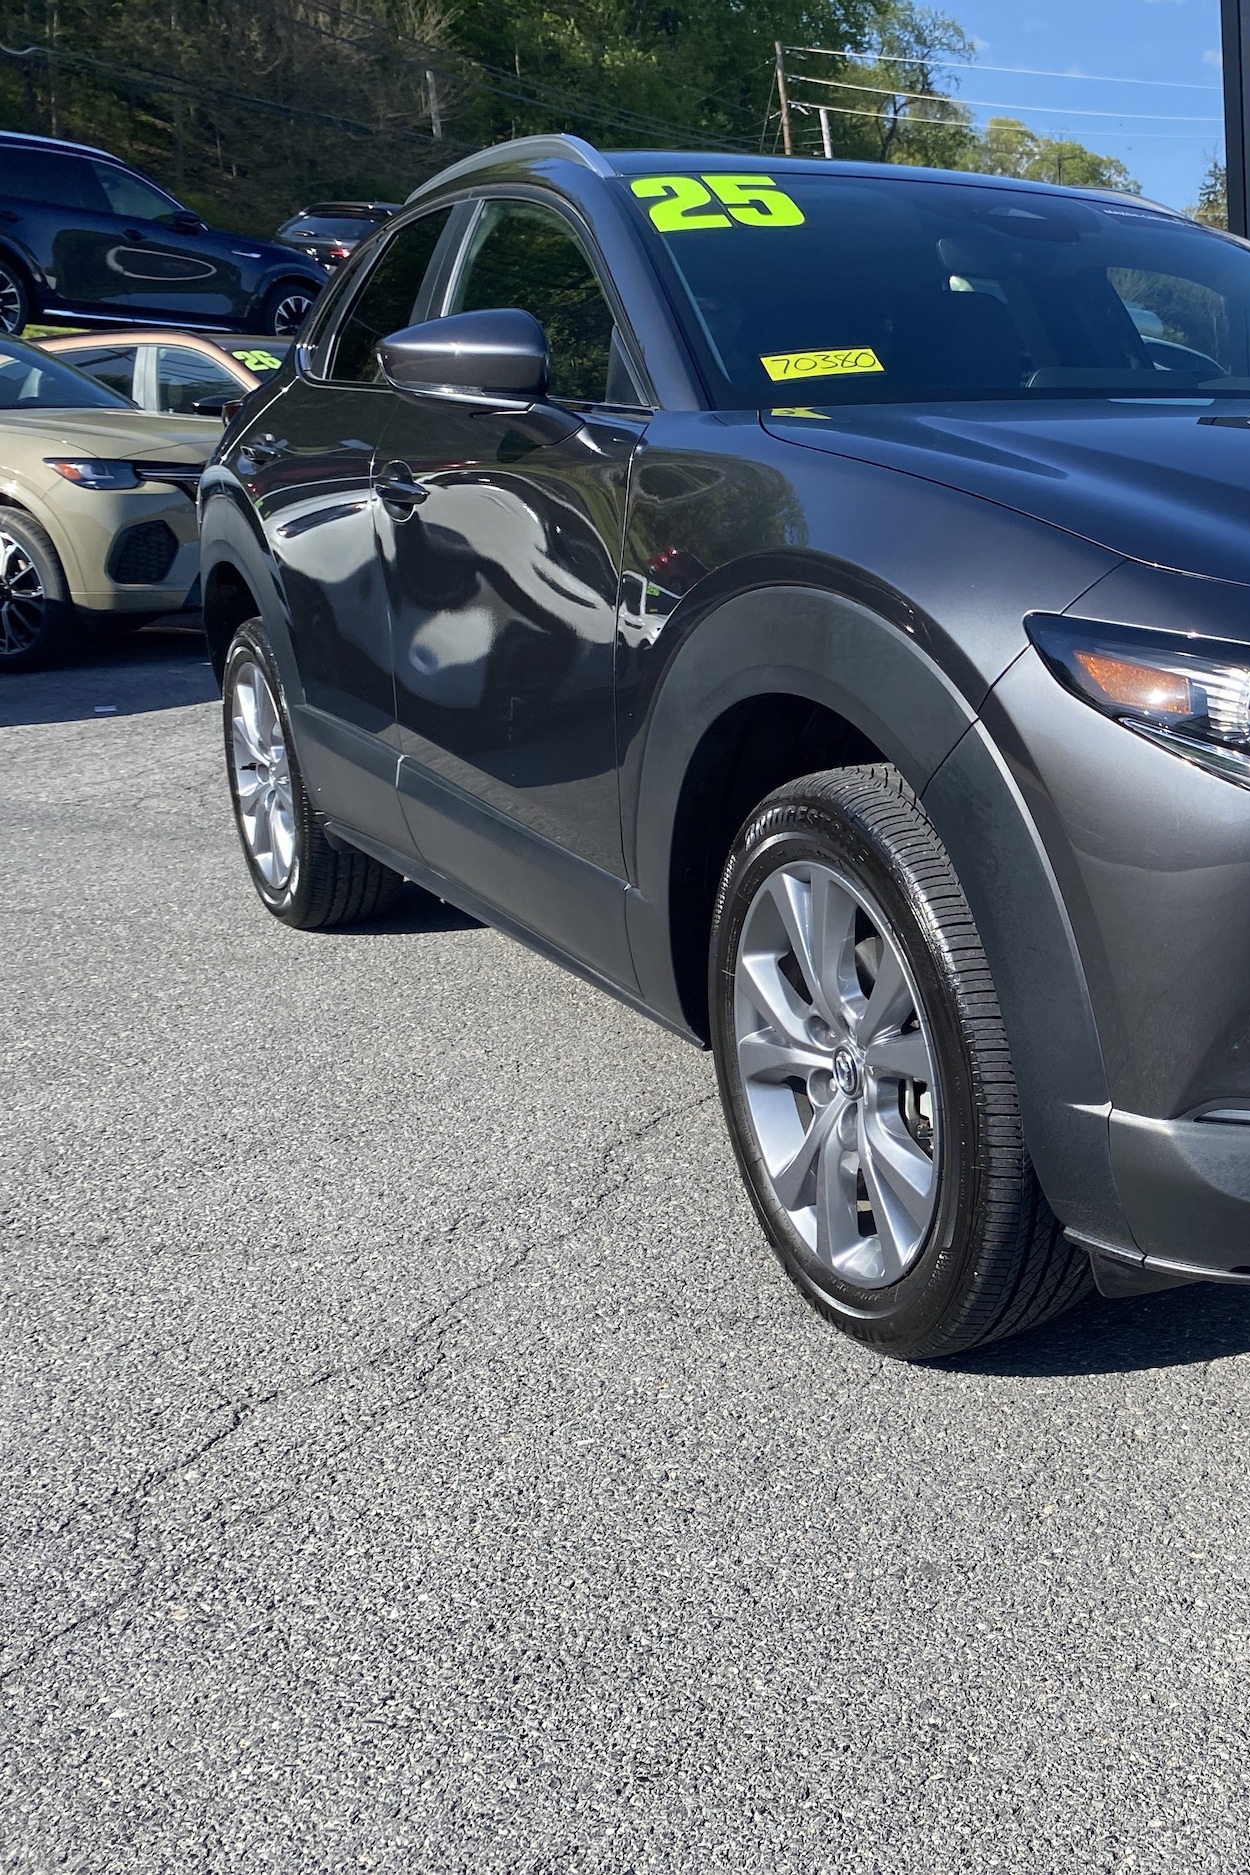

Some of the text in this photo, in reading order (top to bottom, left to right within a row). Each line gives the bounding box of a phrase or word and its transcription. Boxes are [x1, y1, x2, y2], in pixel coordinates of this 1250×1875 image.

[630, 175, 805, 232] 25
[231, 350, 282, 371] 26
[770, 351, 876, 374] 70380
